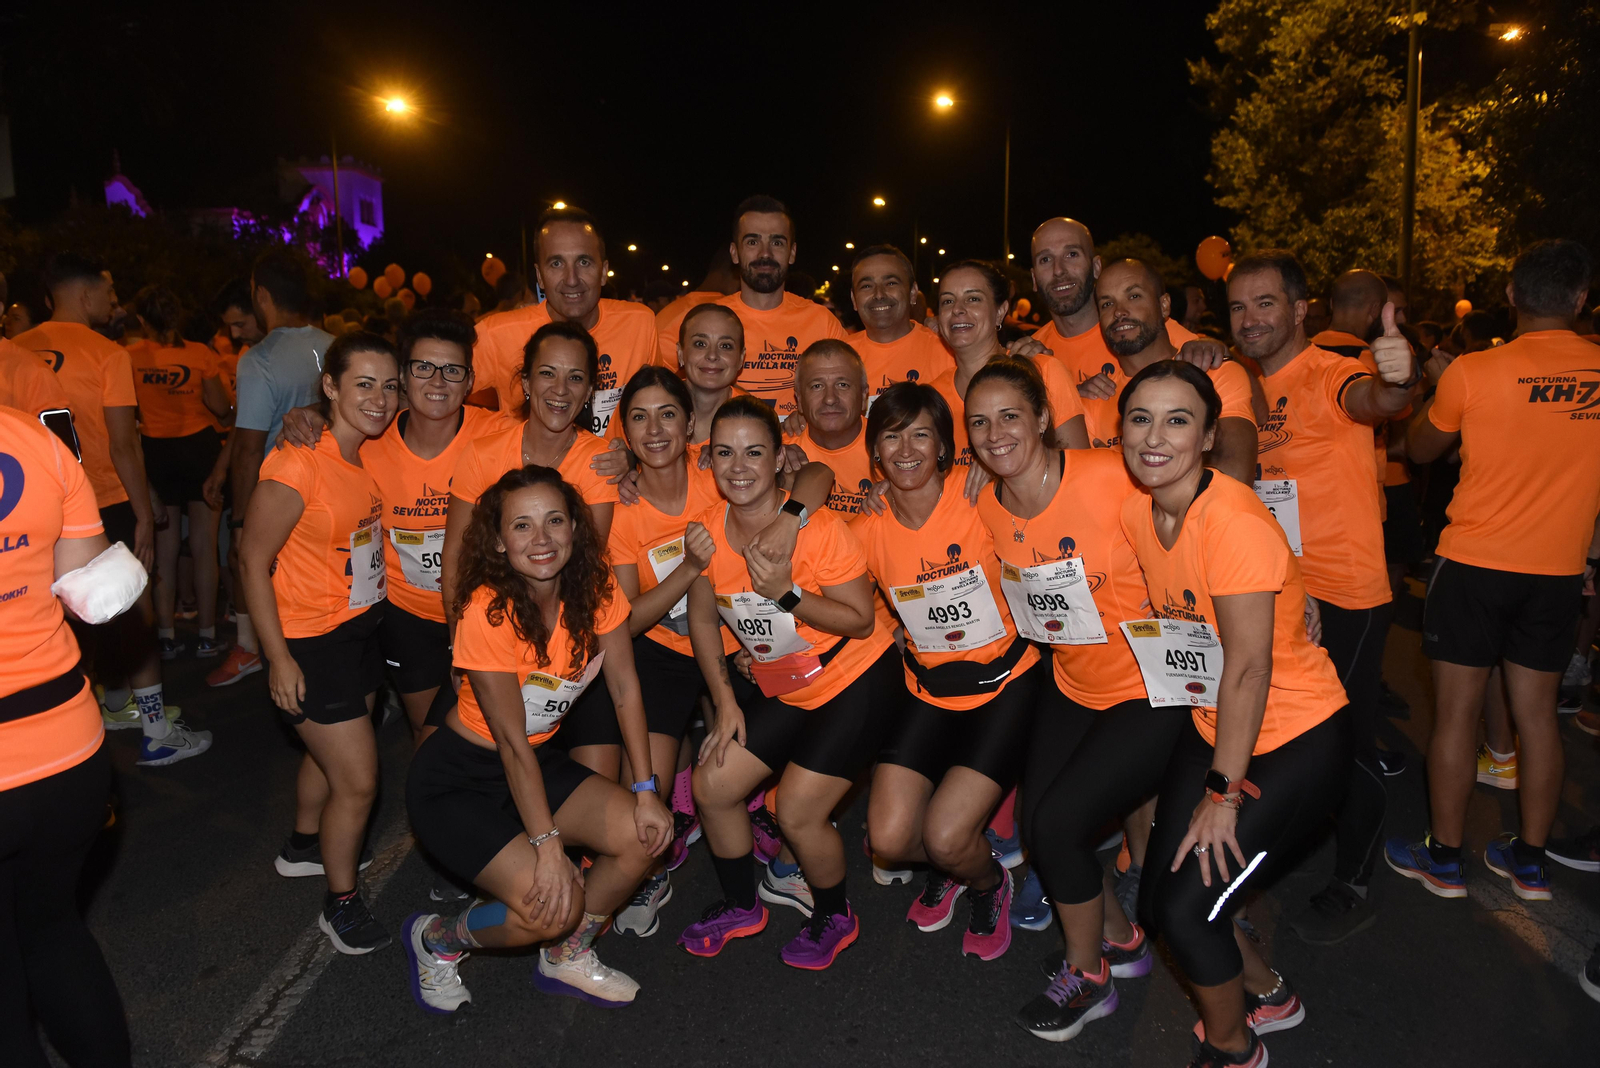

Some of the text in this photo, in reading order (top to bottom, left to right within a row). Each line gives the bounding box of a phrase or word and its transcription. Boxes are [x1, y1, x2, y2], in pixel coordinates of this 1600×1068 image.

[1517, 376, 1577, 385] NOCTURNA
[393, 506, 440, 516] SEVILLA
[916, 561, 970, 583] NOCTURNA
[1027, 593, 1070, 611] 4998
[927, 601, 973, 624] 4993
[737, 618, 773, 636] 4987
[1165, 649, 1208, 673] 4997
